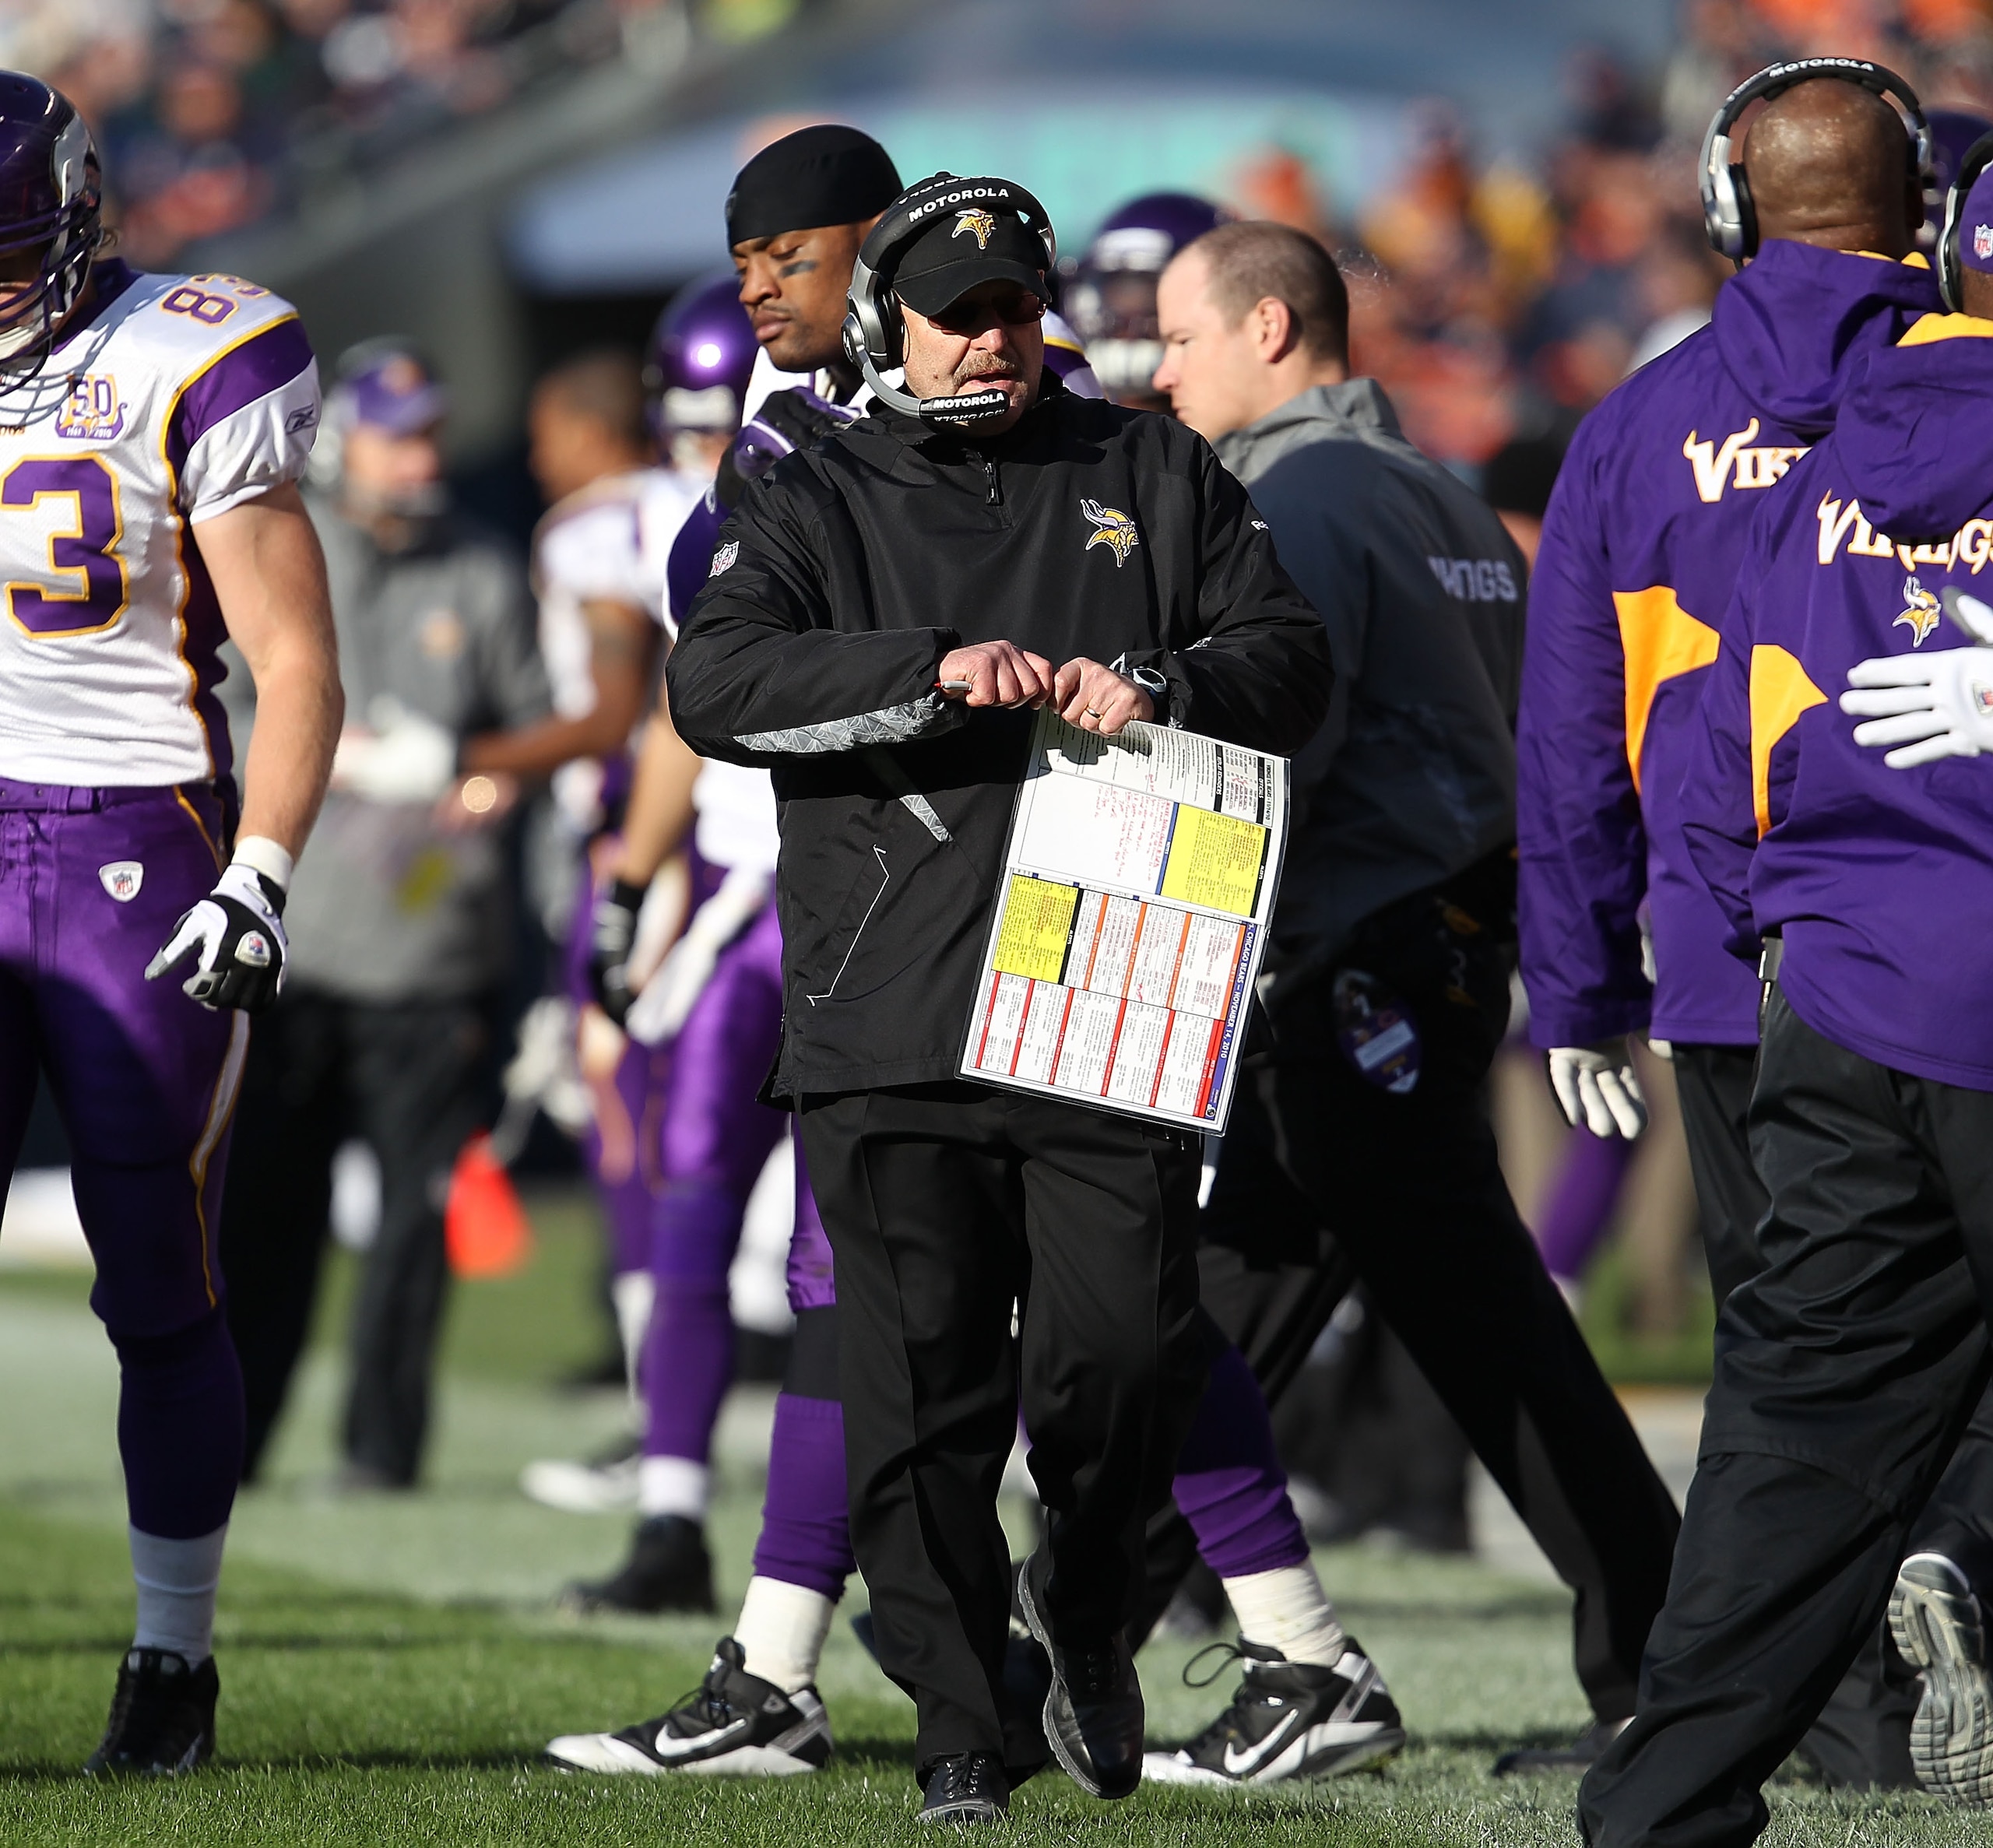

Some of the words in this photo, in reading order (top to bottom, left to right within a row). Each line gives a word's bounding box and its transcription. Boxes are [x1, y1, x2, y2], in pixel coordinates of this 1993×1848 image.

[1770, 57, 1874, 78] MOTOROLA
[908, 188, 1010, 223] MOTOROLA
[933, 392, 1005, 409] MOTOROLA
[1241, 931, 1253, 961] CHICAGO
[1236, 961, 1246, 983] BEARS
[1227, 991, 1240, 1028] NOVEMBER
[1223, 1028, 1232, 1040] 14,
[1219, 1041, 1229, 1059] 2010
